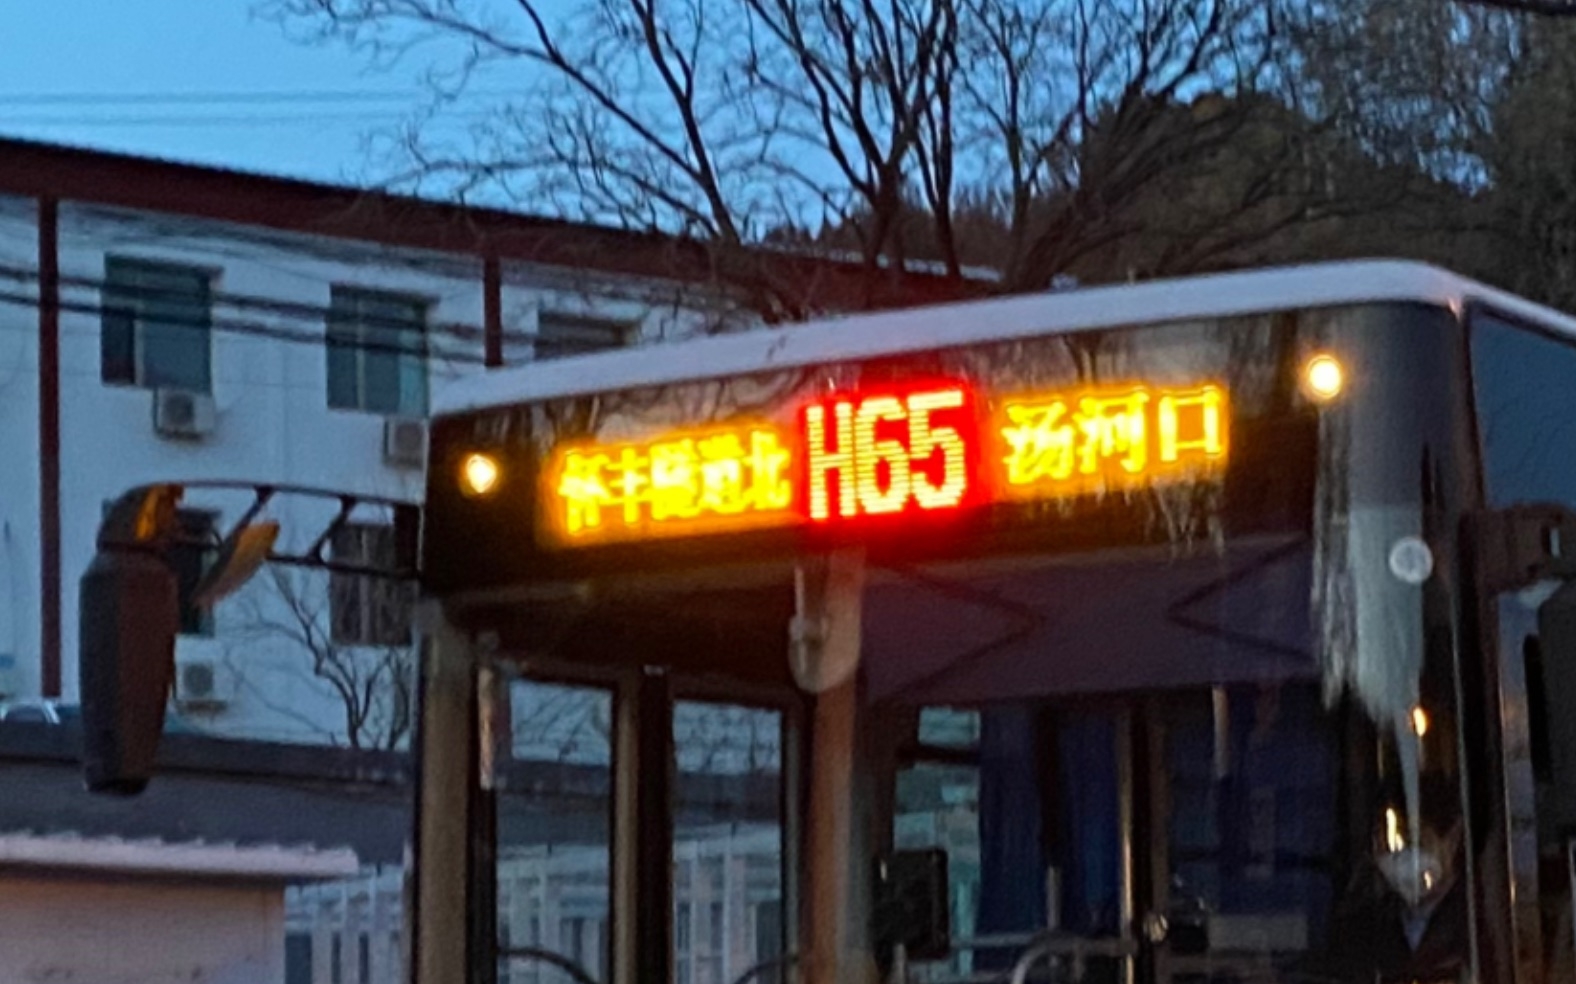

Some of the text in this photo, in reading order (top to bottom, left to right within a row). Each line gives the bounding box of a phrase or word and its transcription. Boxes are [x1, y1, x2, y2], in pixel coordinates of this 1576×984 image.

[805, 390, 967, 520] H65
[1001, 385, 1223, 485] 汤河口
